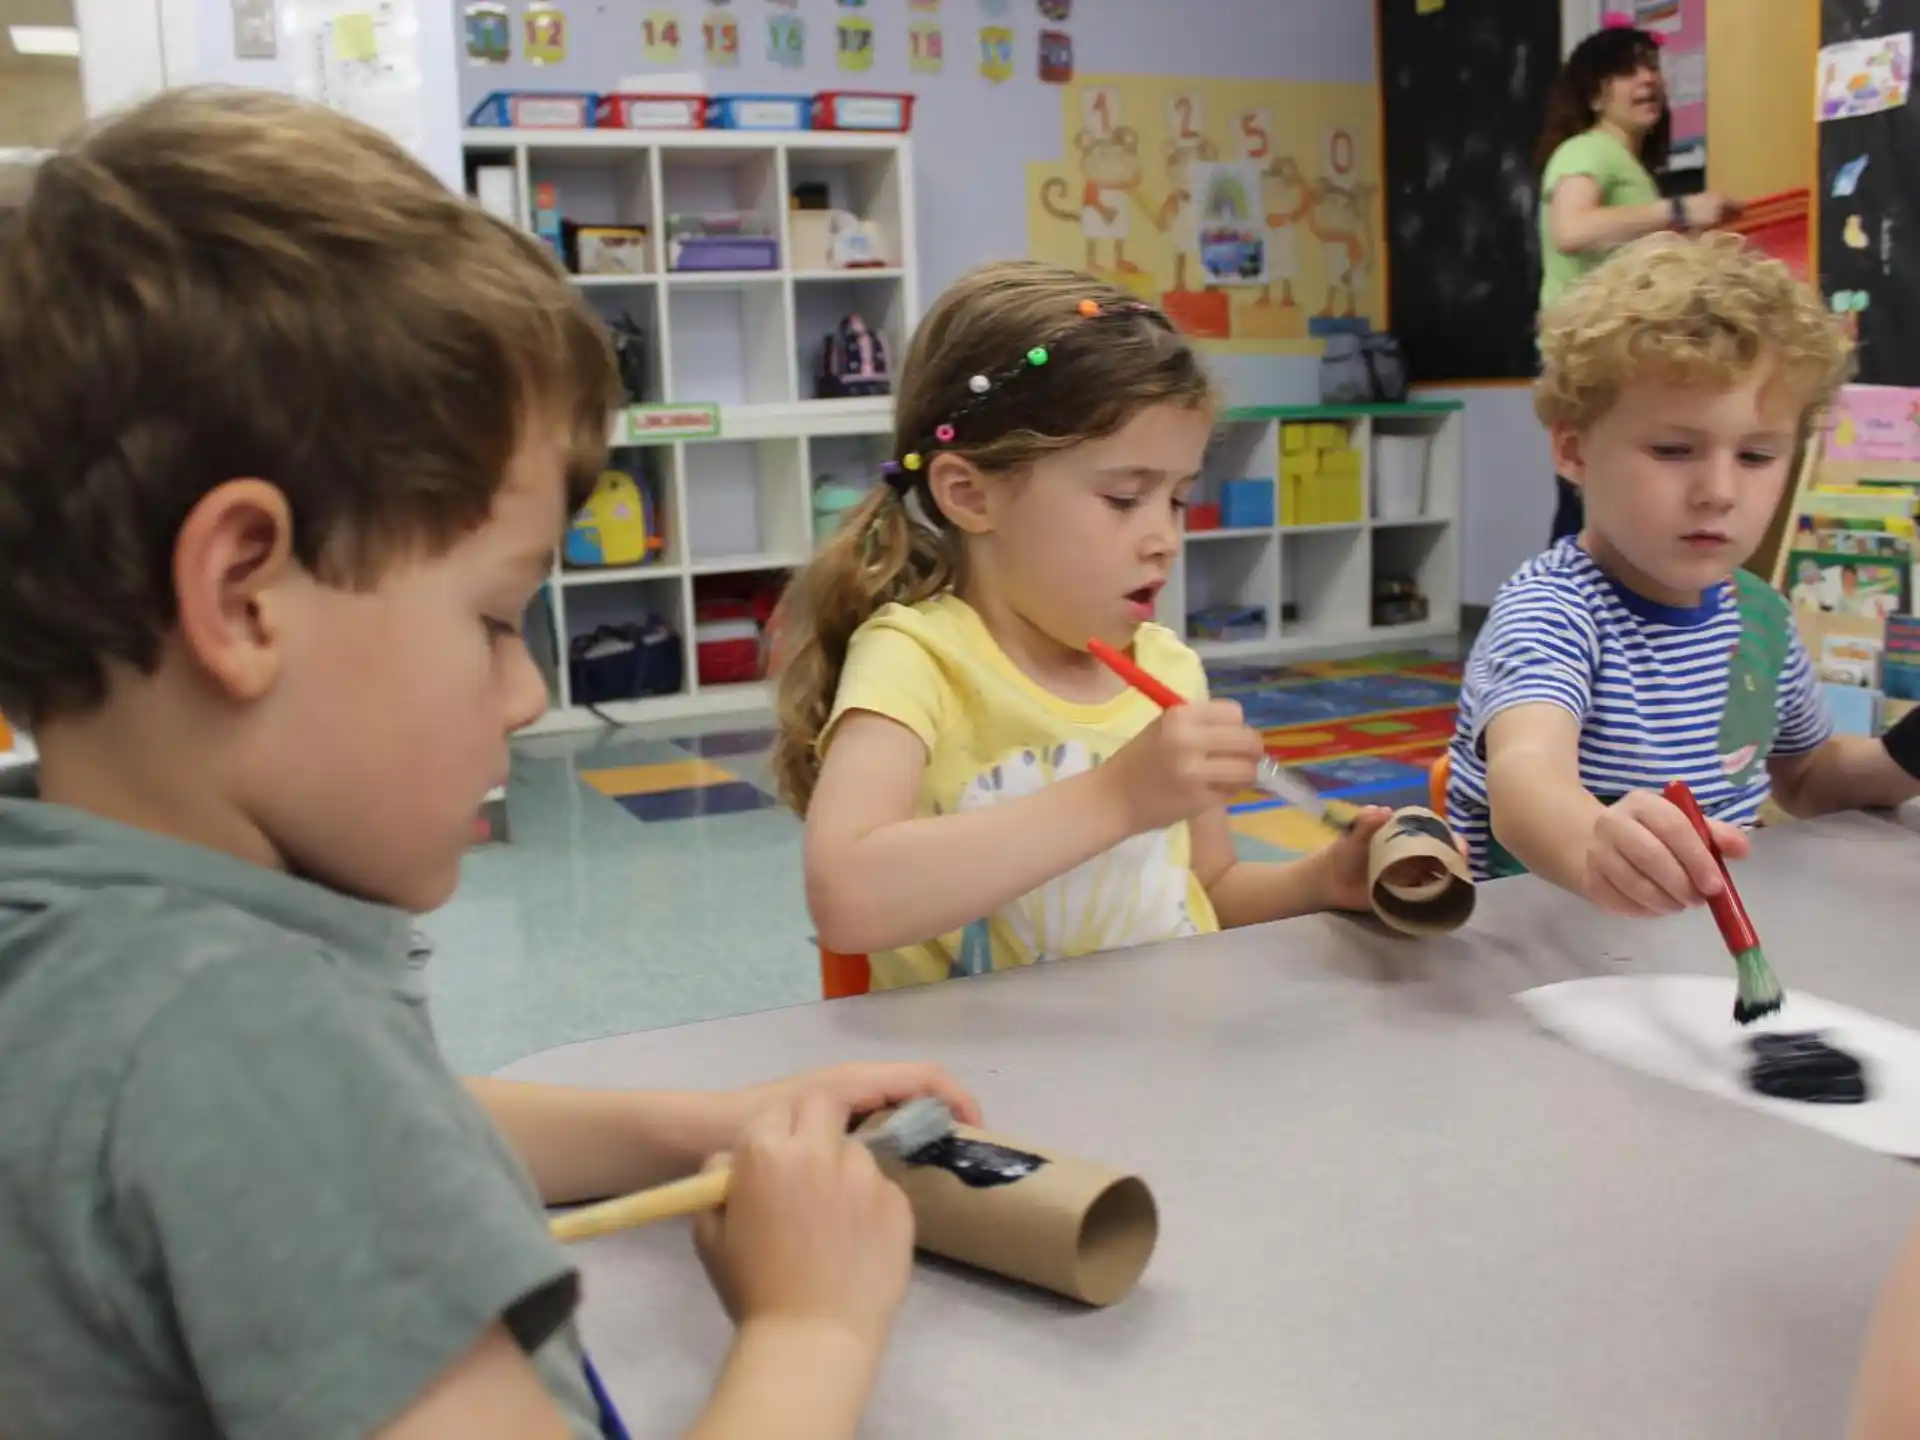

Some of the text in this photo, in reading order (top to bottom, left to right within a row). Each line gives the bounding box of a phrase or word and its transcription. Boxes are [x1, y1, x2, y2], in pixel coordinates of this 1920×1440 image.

[523, 19, 562, 47] 12
[643, 19, 680, 48] 14
[836, 25, 873, 53] 17
[1093, 91, 1110, 134] 1
[1173, 97, 1200, 140] 2
[1239, 113, 1268, 158] 5
